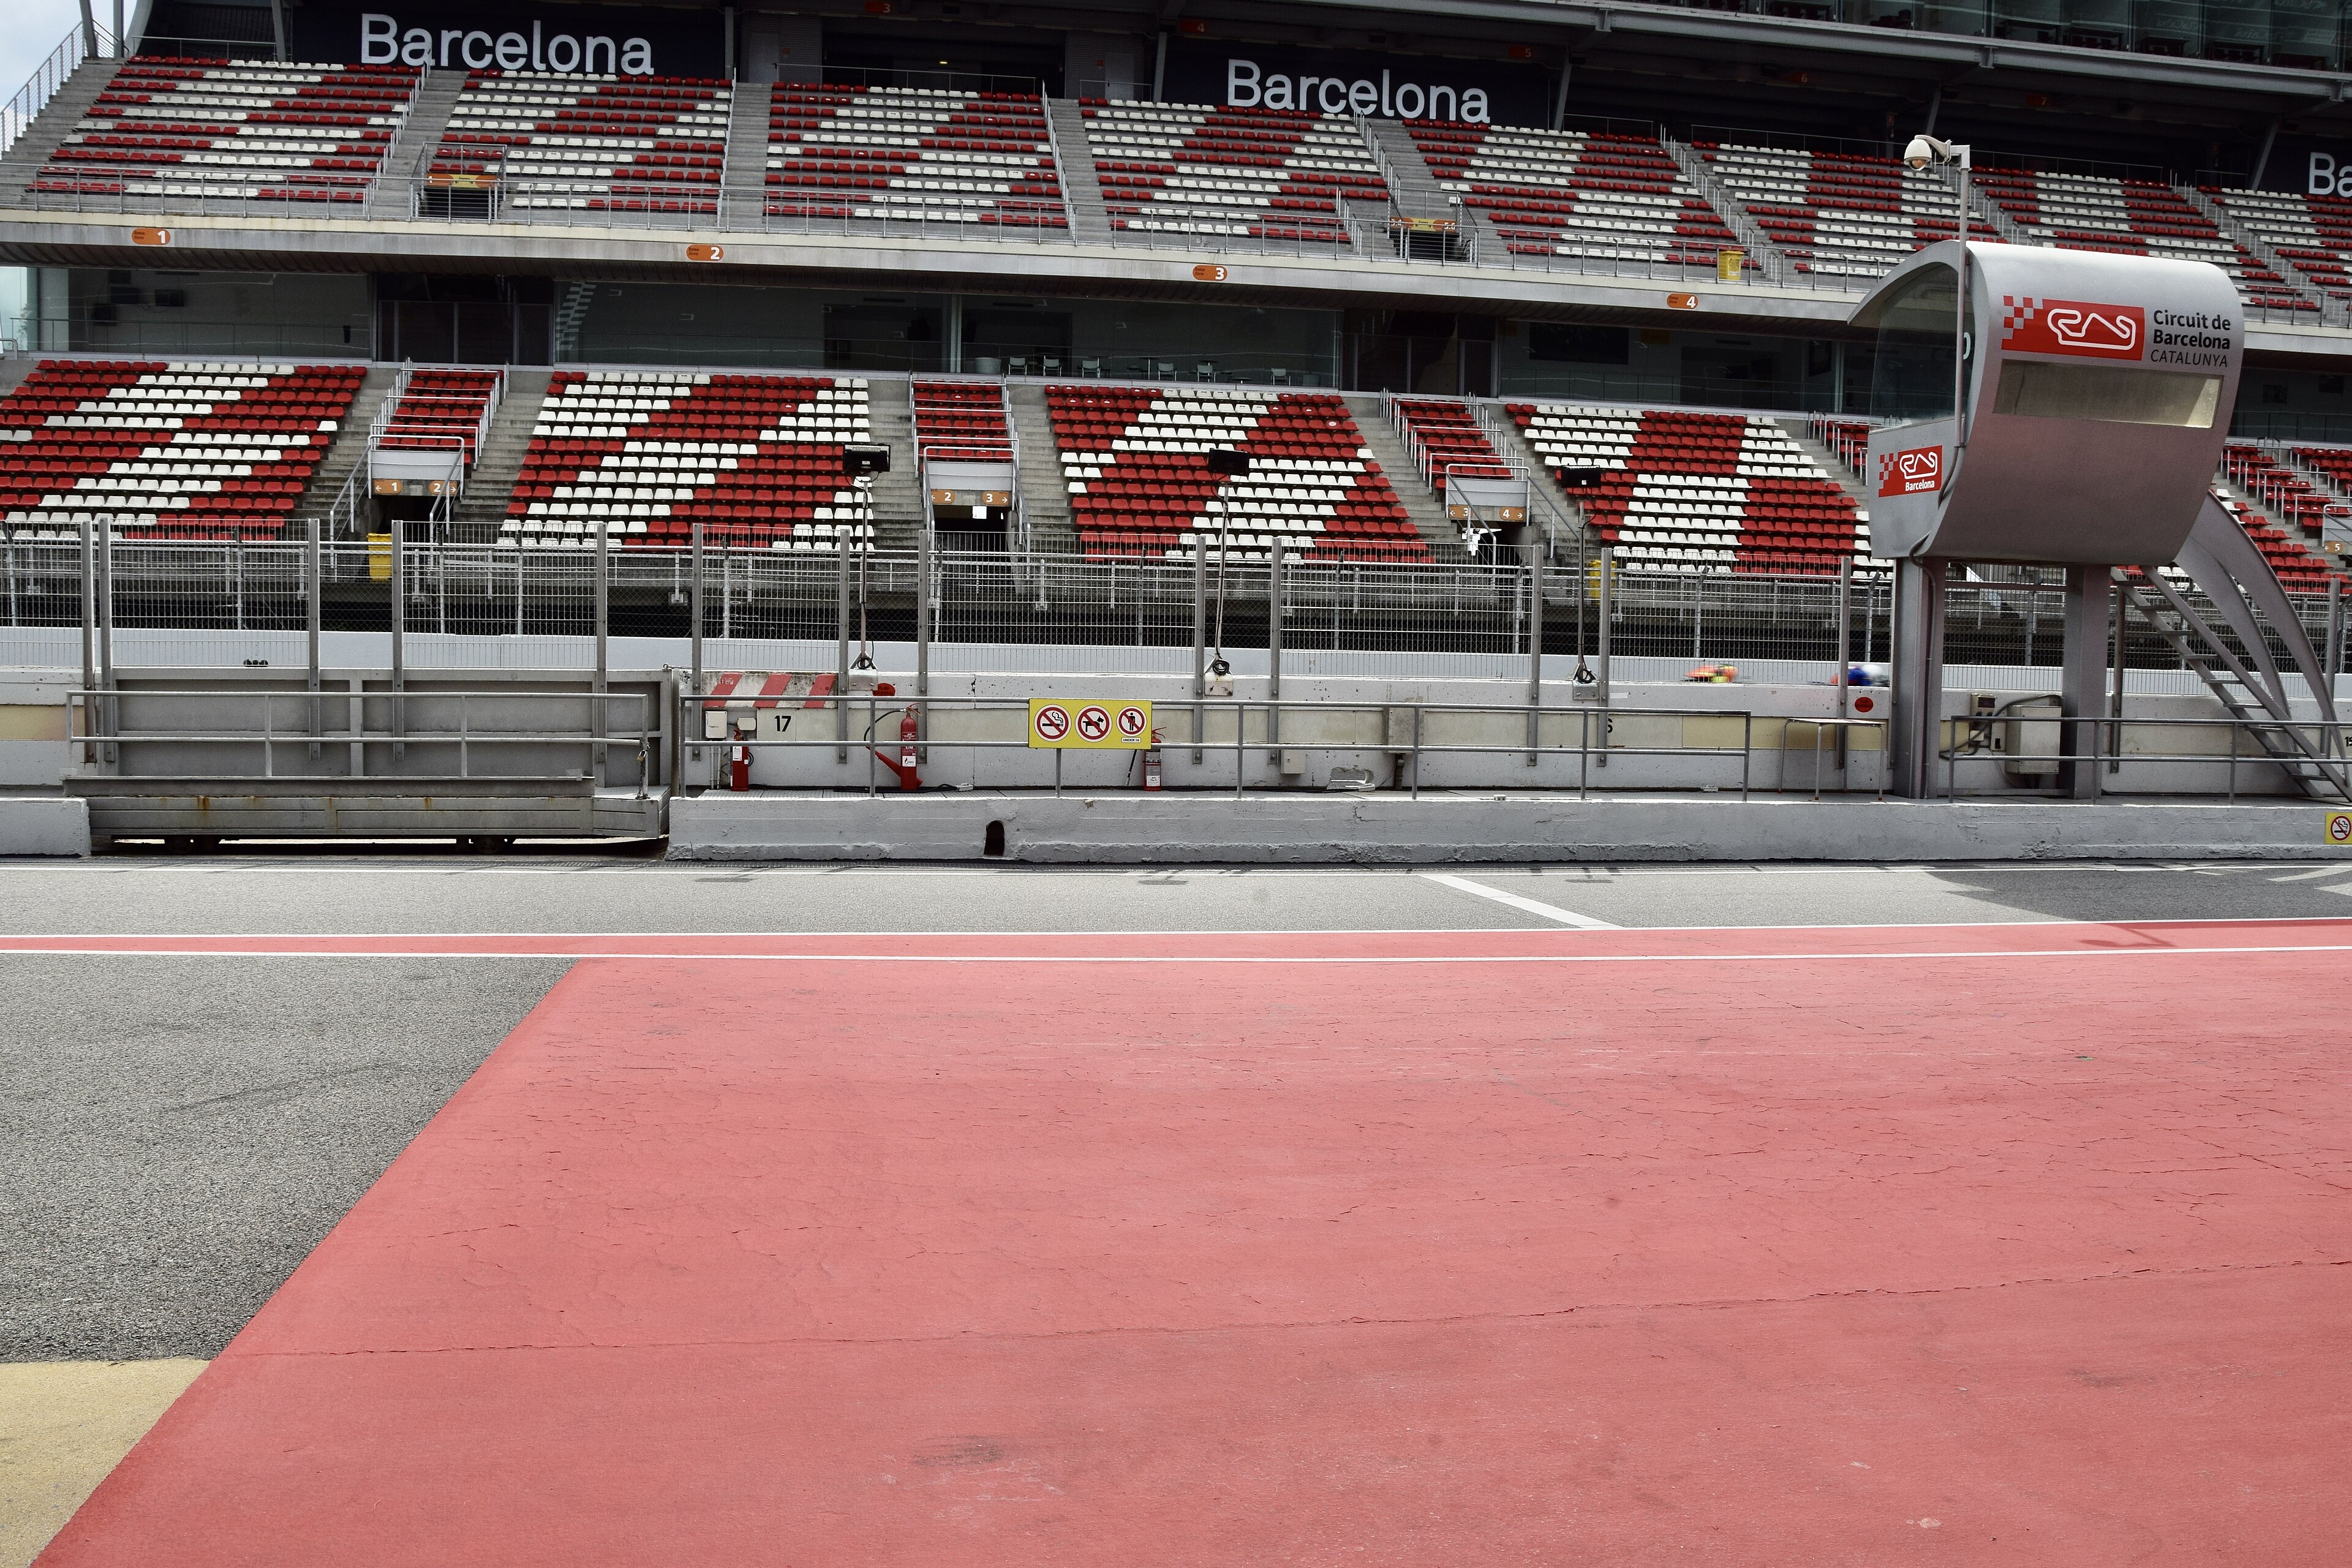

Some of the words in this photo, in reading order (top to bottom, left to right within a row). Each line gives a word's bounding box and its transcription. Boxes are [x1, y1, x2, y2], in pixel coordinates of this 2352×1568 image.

[361, 13, 654, 75] Barcelona
[1227, 59, 1490, 123] Barcelona
[157, 230, 165, 243] 1
[710, 247, 720, 260] 2
[1215, 267, 1224, 279] 3
[1686, 296, 1696, 308] 4
[2154, 309, 2208, 329] Circuit
[2212, 314, 2231, 330] de
[2153, 329, 2231, 349] Barcelona
[2150, 349, 2228, 368] CATALUNYA
[391, 482, 398, 491] 1
[434, 483, 441, 492] 2
[1905, 479, 1935, 491] Barcelona
[944, 492, 951, 501] 2
[986, 494, 993, 502] 3
[1463, 508, 1468, 516] 3
[774, 715, 791, 731] 17
